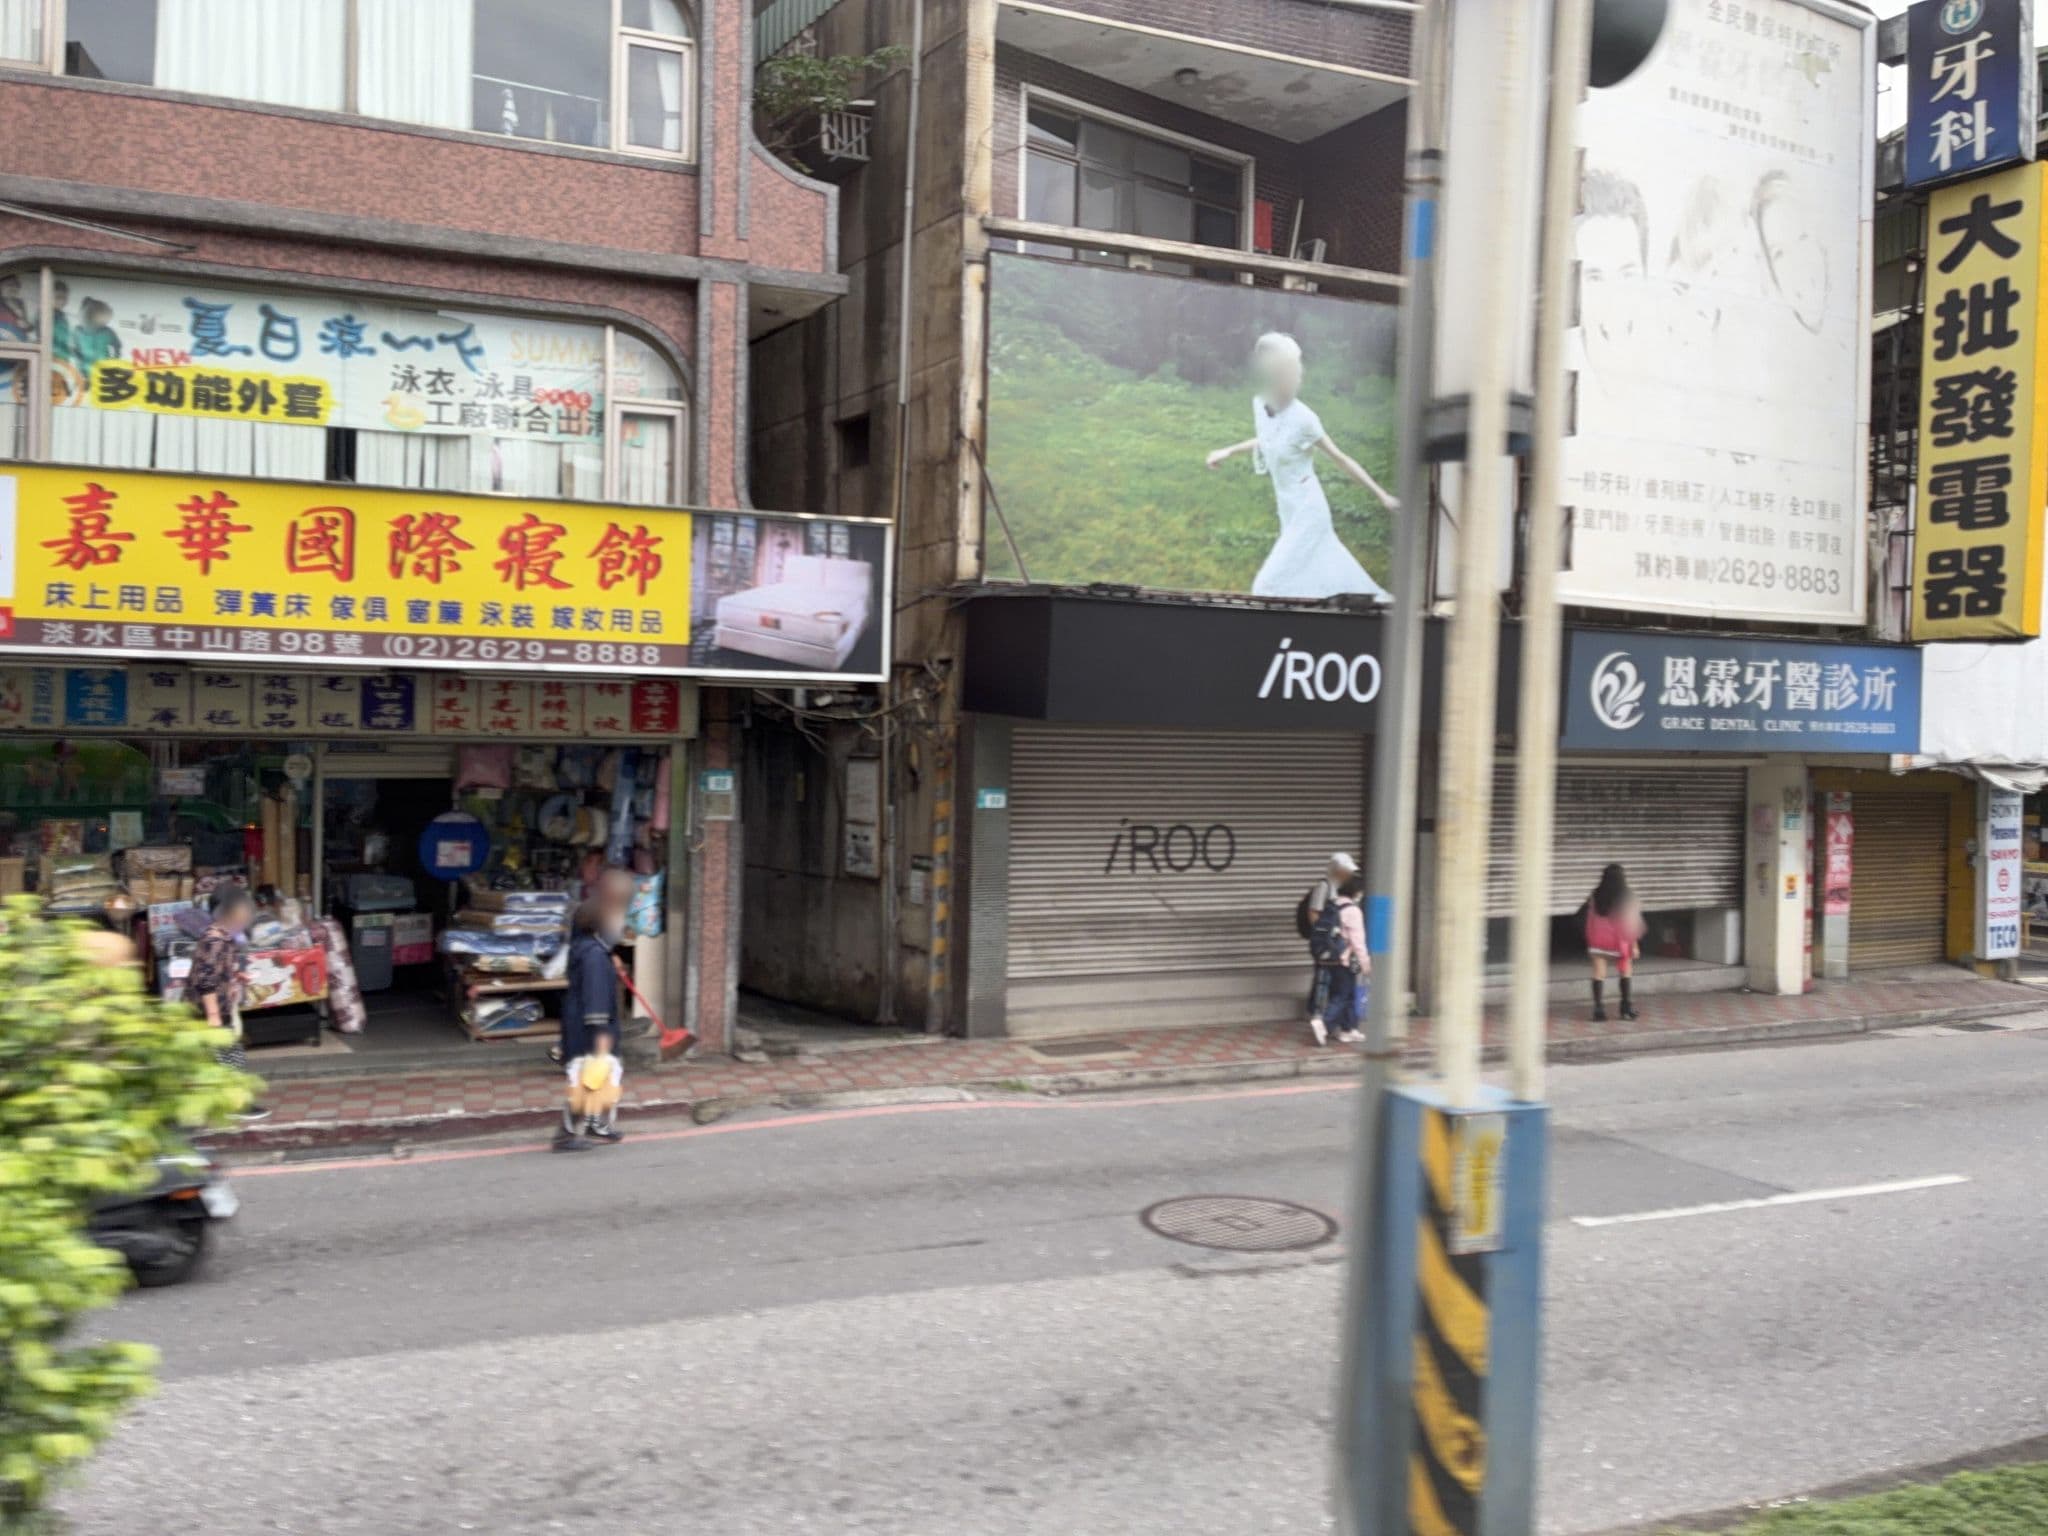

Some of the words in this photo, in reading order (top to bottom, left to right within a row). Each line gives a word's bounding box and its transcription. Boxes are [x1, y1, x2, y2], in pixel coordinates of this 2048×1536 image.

[1929, 31, 1996, 171] 牙科
[132, 347, 192, 366] NEW
[98, 366, 322, 419] 多功能外套
[1924, 194, 2023, 620] 大批發電器
[41, 483, 663, 597] 嘉華國際寢飾
[44, 582, 183, 613] 床上用品
[215, 588, 311, 618] 彈簧床
[331, 595, 388, 622] 傢俱
[479, 601, 535, 629] 泳裝
[41, 622, 363, 656] 淡水區中山路98號
[383, 636, 661, 665] (02)2629-8888
[1660, 655, 1898, 711] 恩霖牙醫診所
[1661, 717, 1705, 730] GRACE
[1711, 718, 1758, 731] DENTAL
[1105, 818, 1236, 875] iROO
[1989, 924, 2017, 949] TECO
